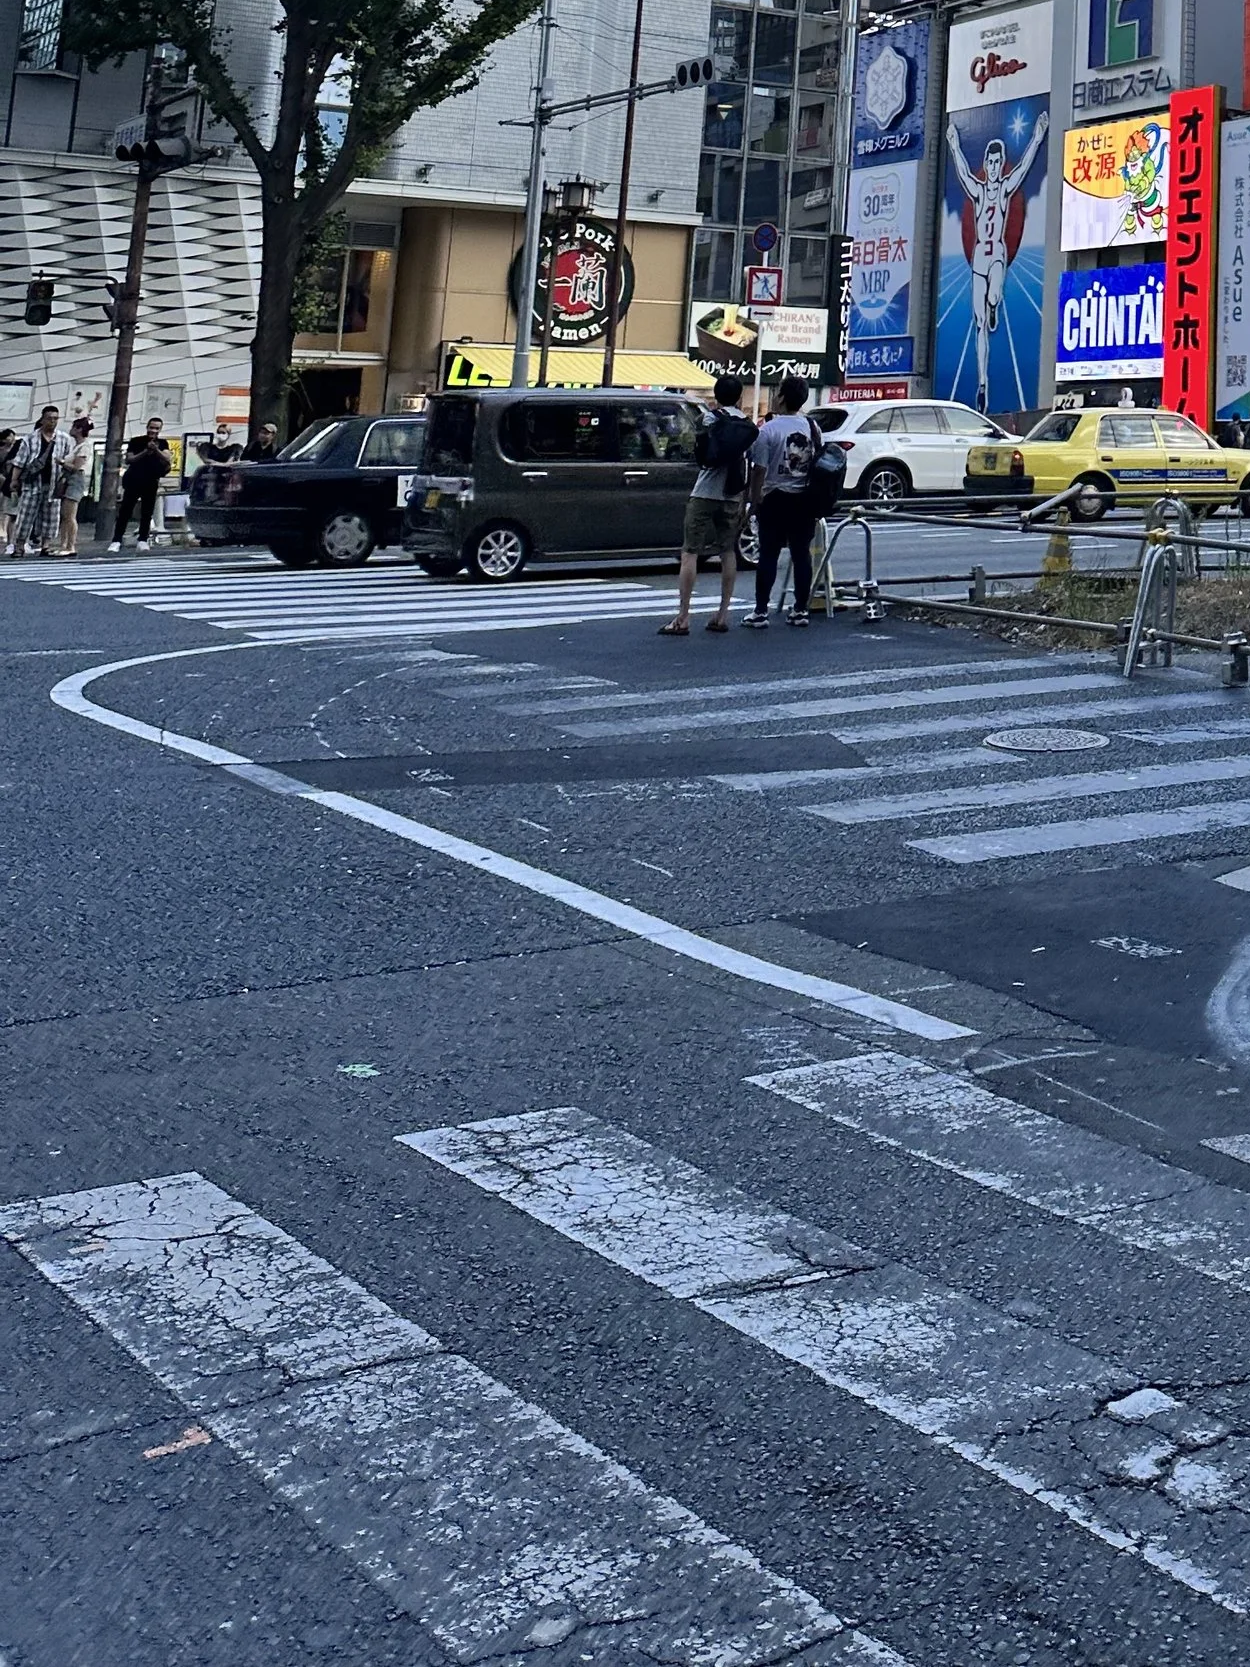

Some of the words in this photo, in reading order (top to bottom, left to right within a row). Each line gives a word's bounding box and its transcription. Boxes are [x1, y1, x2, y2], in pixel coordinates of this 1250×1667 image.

[970, 52, 1028, 94] Glico
[1072, 66, 1172, 110] 日商エステム
[1077, 133, 1114, 153] かぜに
[1072, 152, 1117, 184] 改源
[984, 202, 997, 256] グリコ
[852, 236, 909, 265] 毎日骨太
[861, 270, 890, 294] MBP
[1232, 245, 1244, 322] Asue
[766, 321, 789, 334] New
[791, 321, 821, 334] Brand
[773, 311, 821, 324] CHIRAN's
[777, 334, 812, 345] Ramen
[840, 389, 875, 400] LOTTERIA
